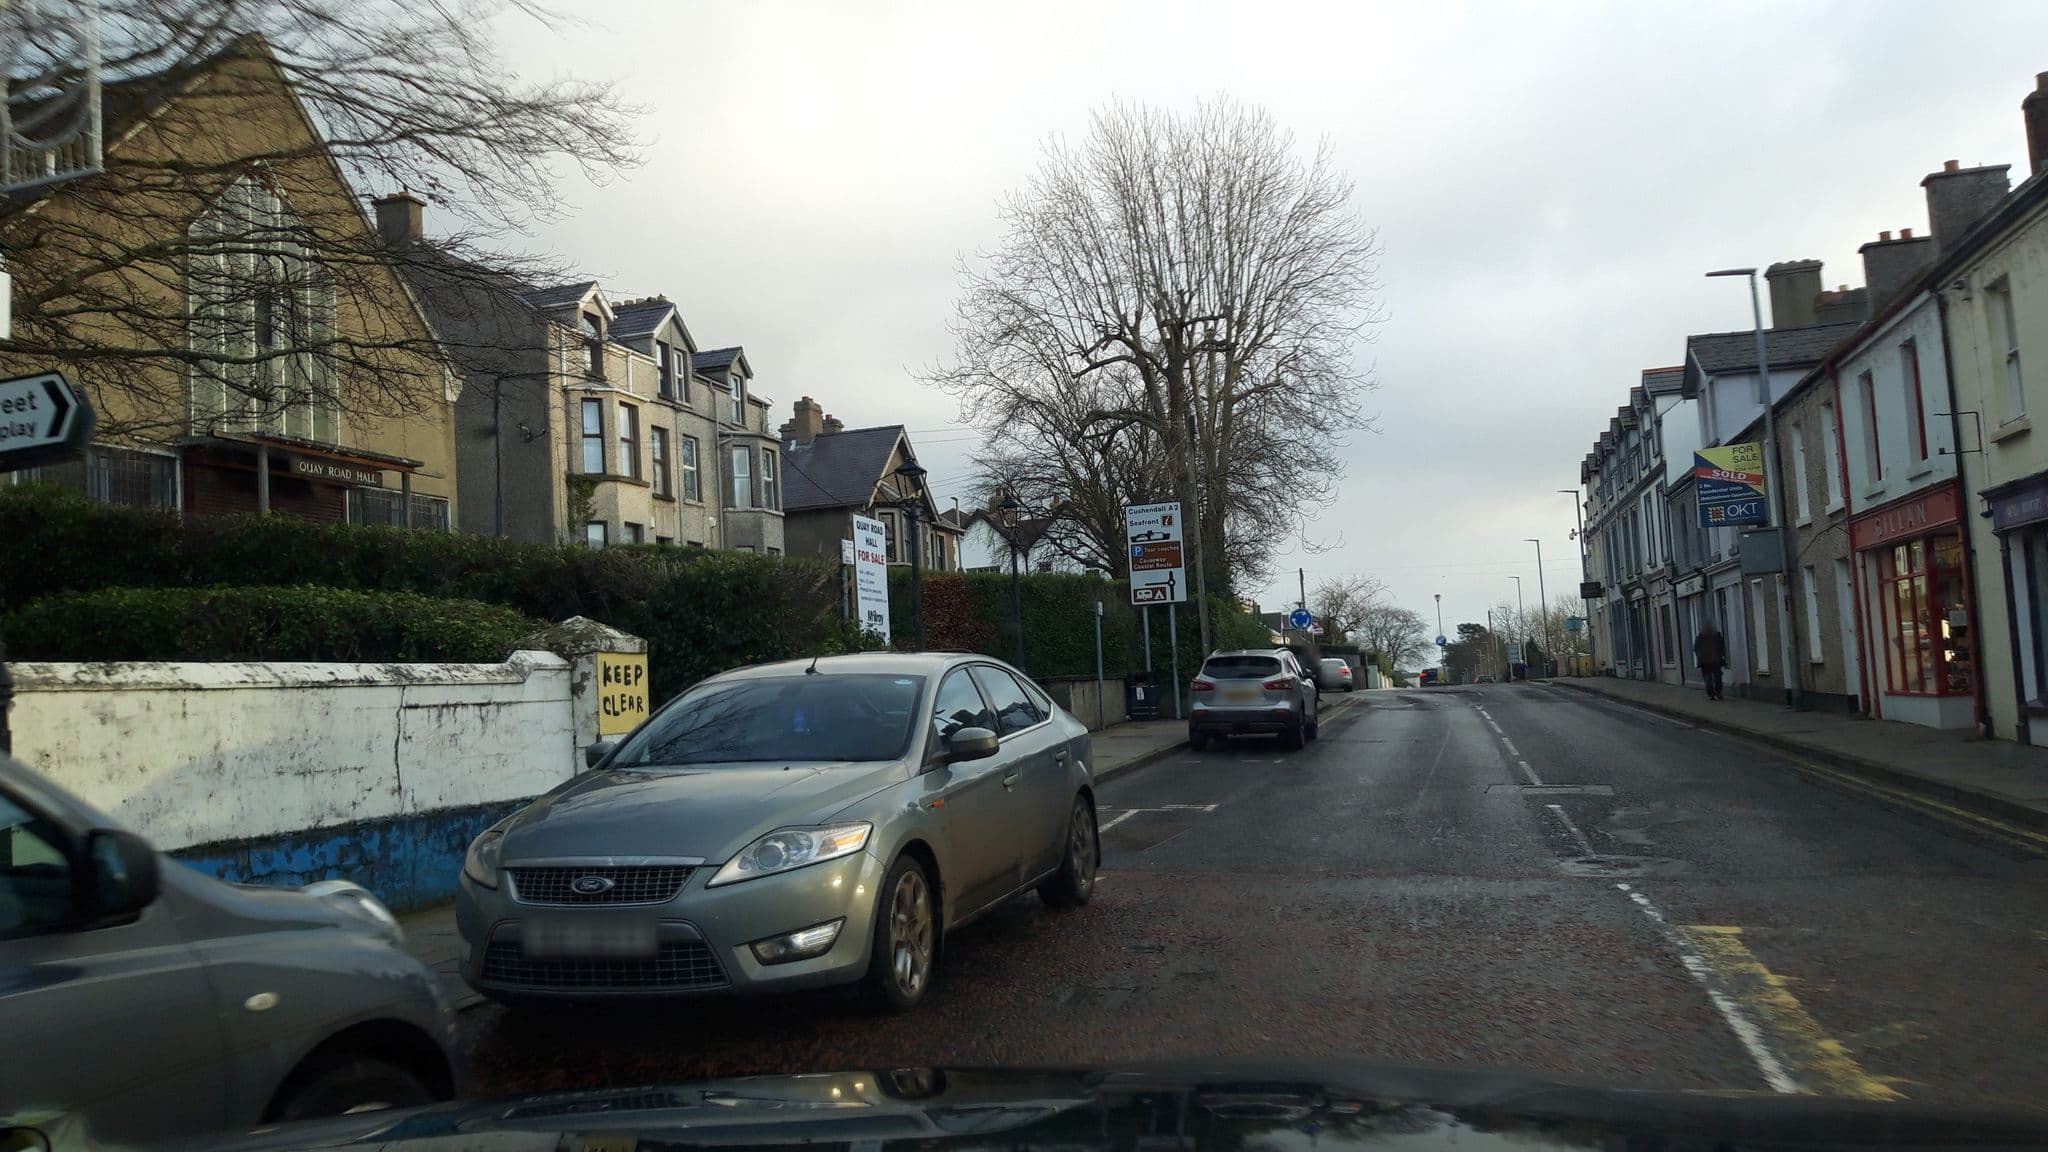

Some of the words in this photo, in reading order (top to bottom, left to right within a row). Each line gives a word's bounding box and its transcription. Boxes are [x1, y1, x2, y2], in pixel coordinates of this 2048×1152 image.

[1732, 445, 1753, 454] FOR
[1732, 454, 1760, 463] SALE
[299, 461, 324, 475] QUAY
[328, 466, 352, 480] ROAD
[356, 471, 377, 484] HALL
[1712, 469, 1748, 480] SOLD
[1128, 505, 1166, 515] Cushendall
[1727, 502, 1759, 517] OKT
[856, 520, 869, 532] QUAY
[870, 523, 884, 535] ROAD
[865, 535, 878, 548] HALL
[857, 549, 870, 562] FOR
[870, 552, 885, 565] SALE
[603, 660, 643, 687] KEEP
[603, 693, 644, 716] CLEAR
